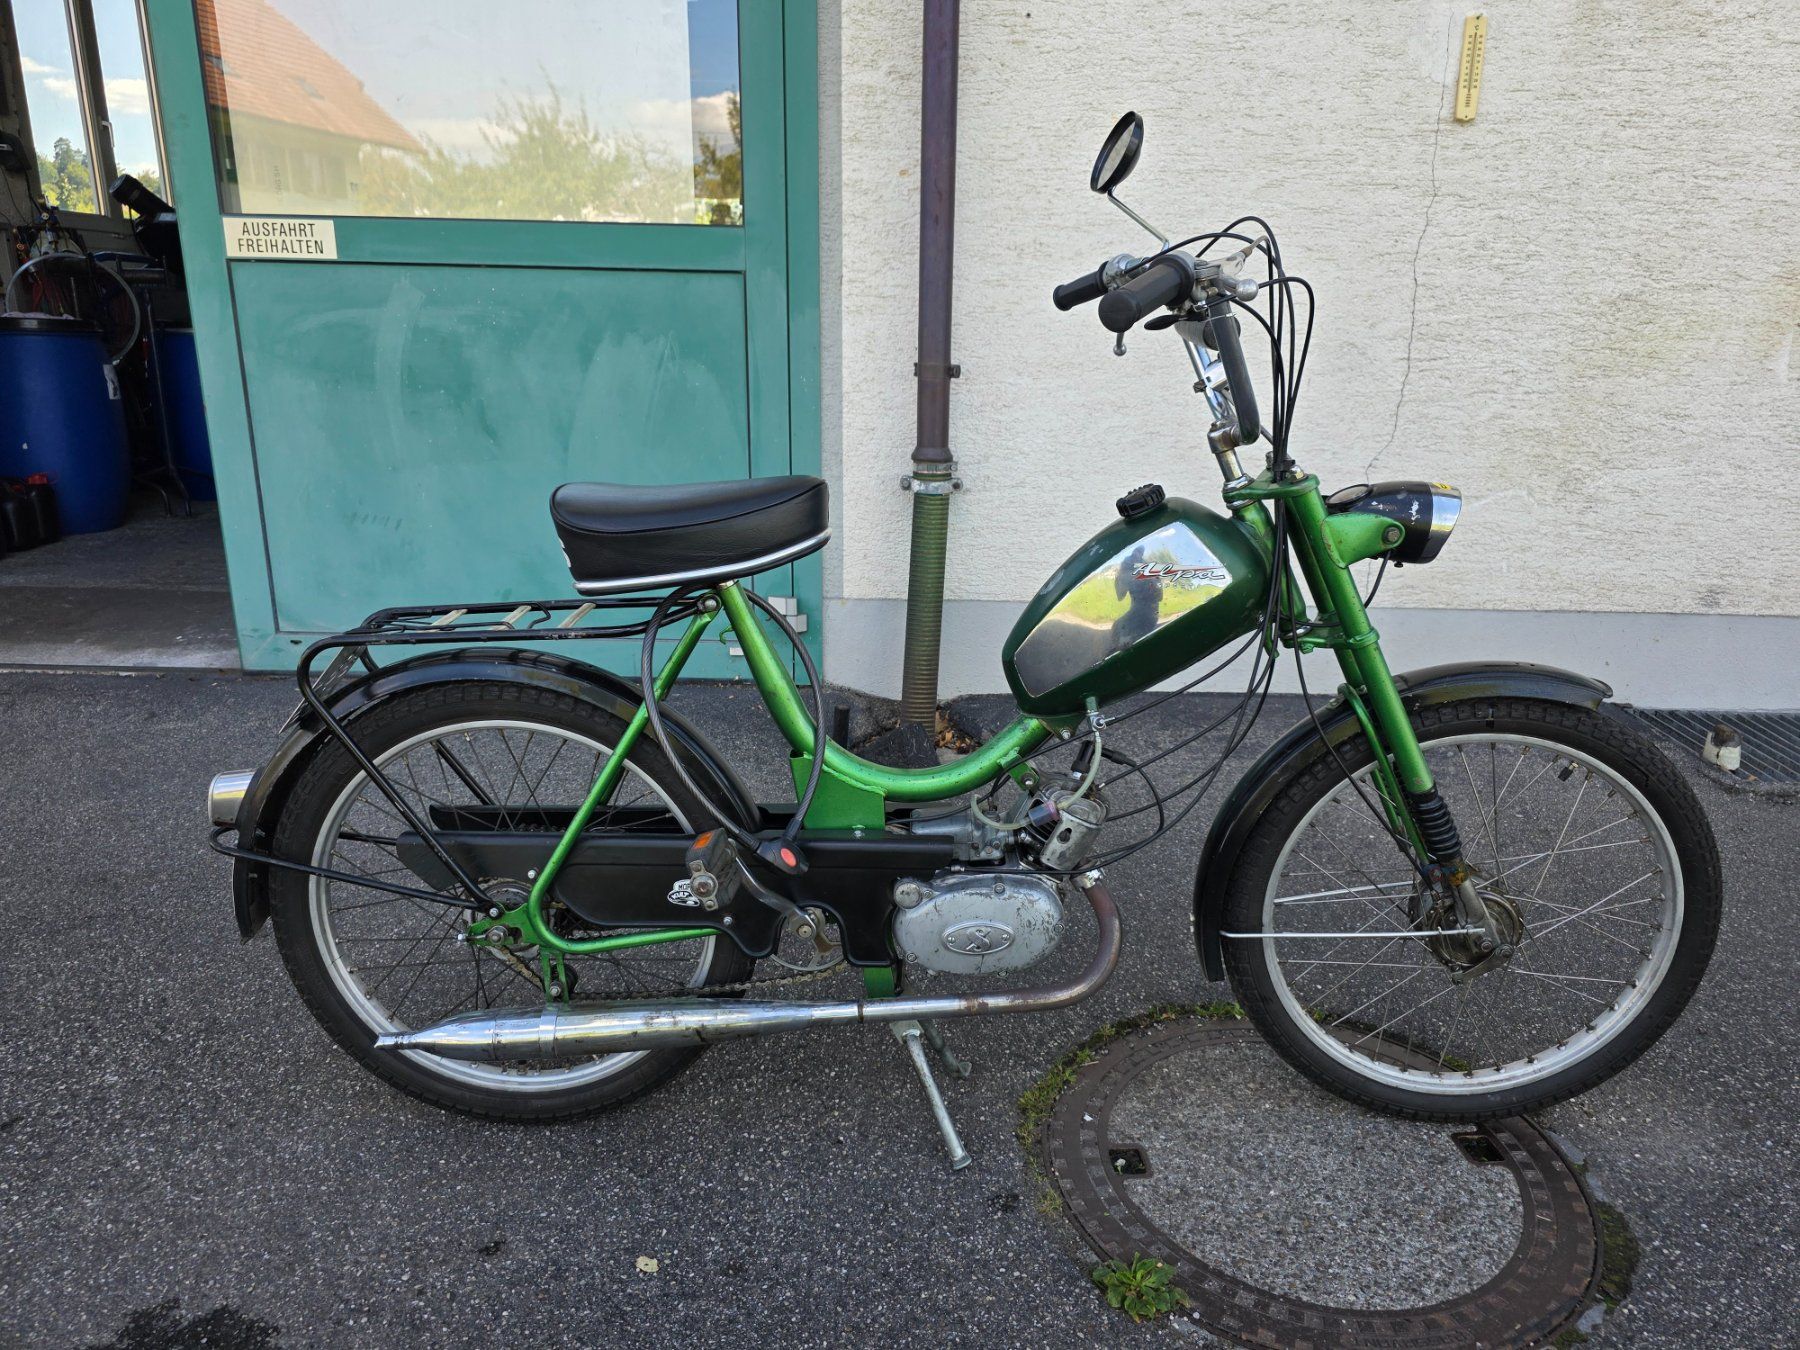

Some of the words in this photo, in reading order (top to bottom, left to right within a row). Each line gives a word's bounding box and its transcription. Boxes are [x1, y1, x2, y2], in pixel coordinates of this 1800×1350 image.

[242, 222, 315, 238] AUSFAHRT
[238, 238, 324, 254] FREIHALTEN
[1132, 562, 1226, 582] Alpa
